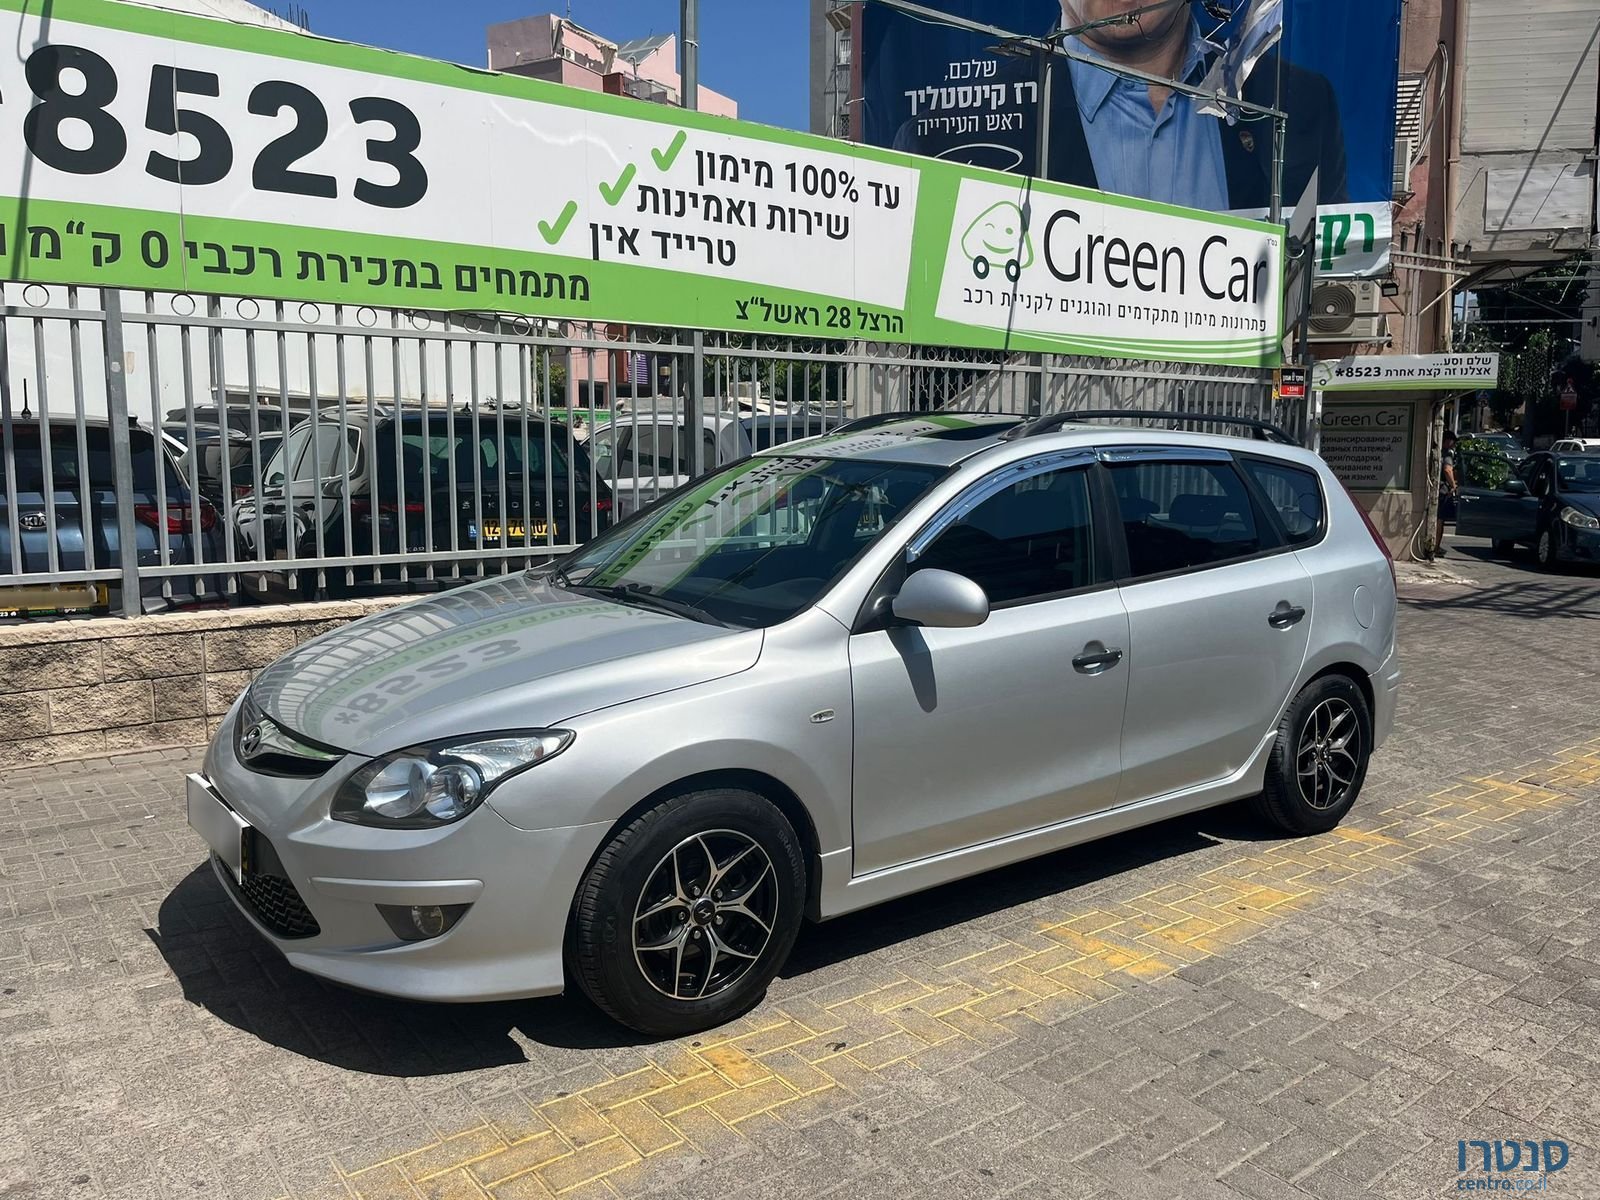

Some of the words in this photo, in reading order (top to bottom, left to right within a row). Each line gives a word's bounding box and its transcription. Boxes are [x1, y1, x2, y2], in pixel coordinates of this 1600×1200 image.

[944, 59, 997, 81] שלכם,
[904, 83, 1006, 116] קינסטליך
[1013, 81, 1038, 104] רז
[0, 44, 428, 208] 8523
[917, 115, 979, 136] העירייה
[985, 112, 1023, 132] ראש
[695, 149, 773, 189] מימון
[785, 162, 859, 203] 100%
[636, 184, 756, 228] ואמינות
[868, 180, 900, 210] עד
[766, 204, 849, 240] שירות
[141, 230, 169, 269] 0
[589, 222, 640, 260] אין
[652, 230, 736, 267] טרייד
[184, 240, 282, 278] רכבי
[1043, 209, 1185, 296] Green
[1198, 235, 1267, 304] Car
[297, 250, 442, 290] במכירת
[455, 264, 590, 301] מתמחים
[963, 287, 993, 305] רכב
[1001, 292, 1053, 315] לקניית
[1061, 298, 1111, 318] והוגנים
[826, 305, 851, 329] 28
[856, 308, 904, 334] הרצל
[1118, 303, 1179, 327] מתקדמים
[1183, 309, 1216, 330] מימון
[1221, 315, 1267, 333] פתרונות
[1444, 368, 1457, 376] זה
[1460, 367, 1491, 375] אצלנו
[1466, 356, 1492, 365] שלם
[1385, 369, 1415, 377] אחרת
[1418, 368, 1441, 378] קצת
[1322, 411, 1371, 426] Green
[1375, 411, 1405, 426] Car
